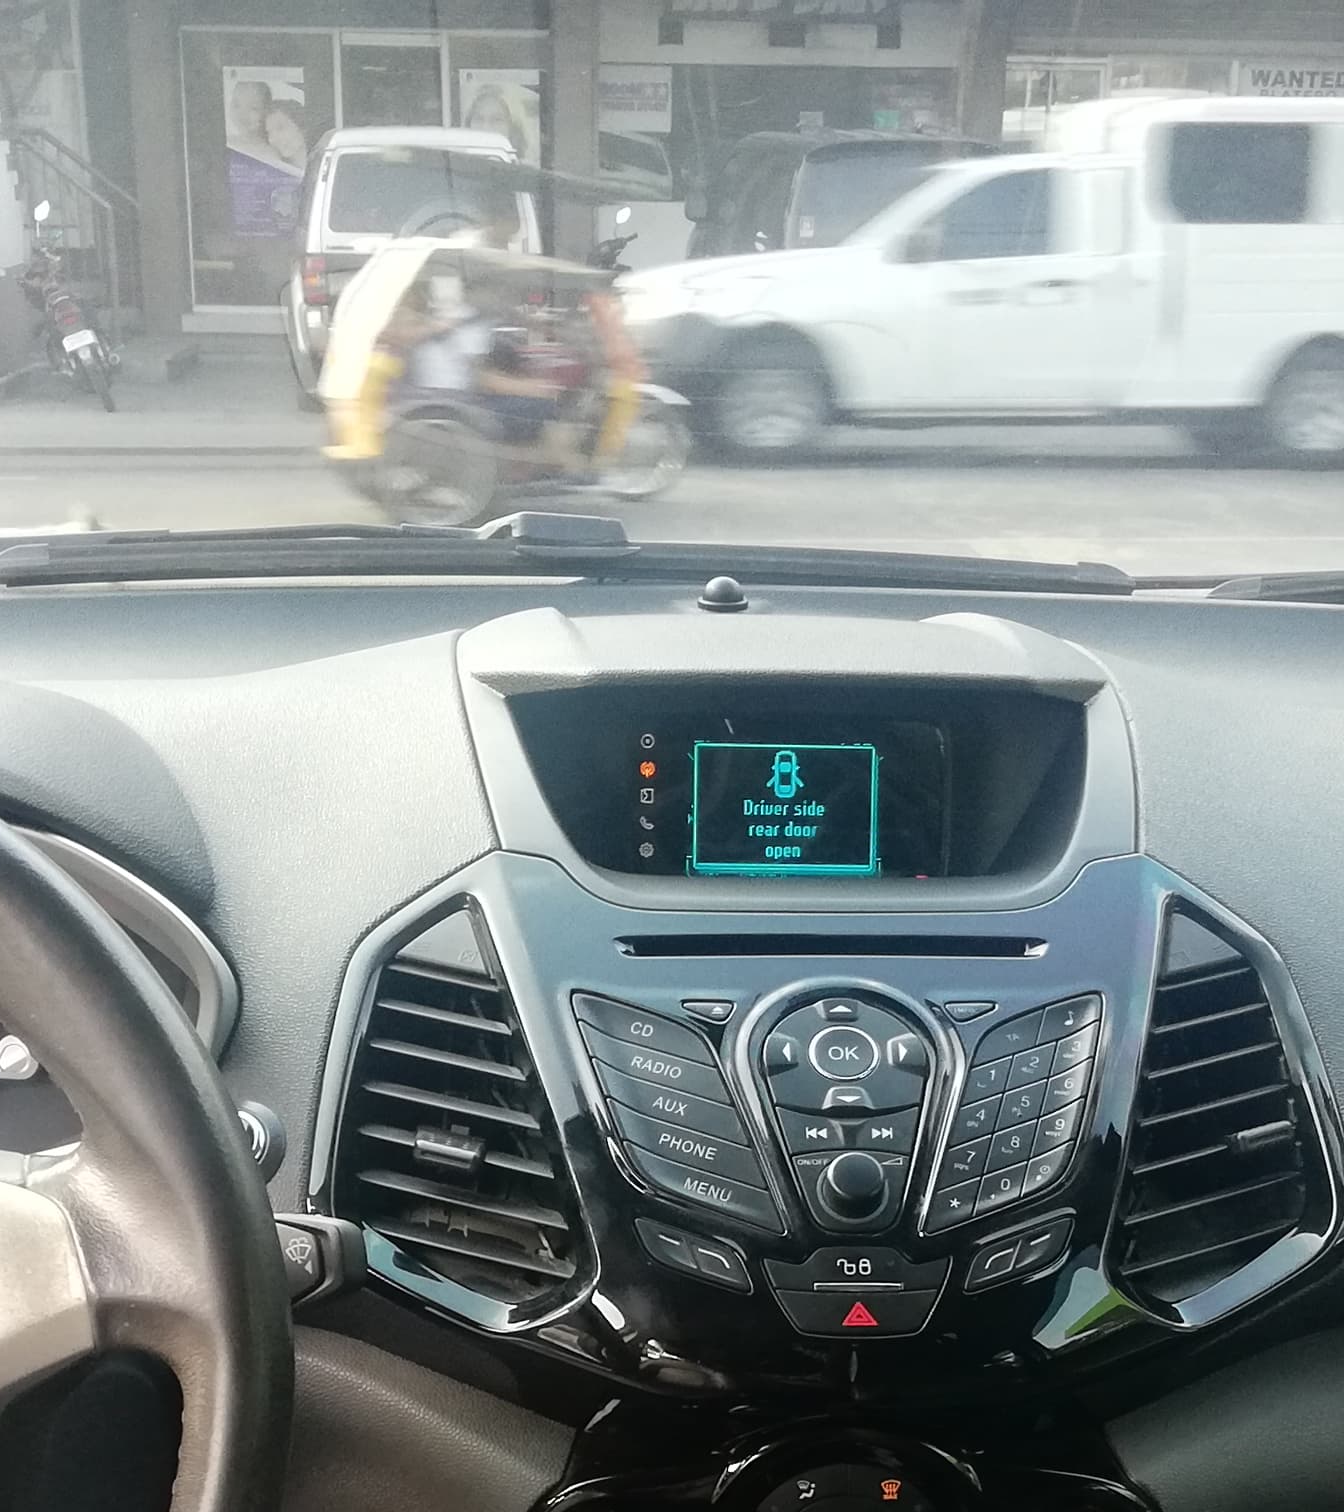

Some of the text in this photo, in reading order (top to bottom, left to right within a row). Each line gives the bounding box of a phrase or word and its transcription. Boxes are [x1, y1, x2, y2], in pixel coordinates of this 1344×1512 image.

[743, 799, 825, 816] Driver side
[748, 820, 819, 837] rear door
[765, 845, 801, 859] open
[630, 1021, 654, 1037] CD
[1071, 1040, 1081, 1051] 3
[828, 1046, 859, 1061] OK
[630, 1055, 682, 1079] RADIO
[1029, 1056, 1040, 1068] 2
[989, 1069, 996, 1081] 1
[1064, 1077, 1074, 1089] 6
[652, 1096, 688, 1116] AUX
[1020, 1095, 1030, 1108] 5
[975, 1109, 985, 1121] 4
[1054, 1118, 1065, 1130] 9
[658, 1133, 718, 1161] PHONE
[1010, 1135, 1020, 1148] 8
[966, 1150, 976, 1163] 7
[683, 1177, 733, 1202] MENU
[1000, 1178, 1011, 1191] 0
